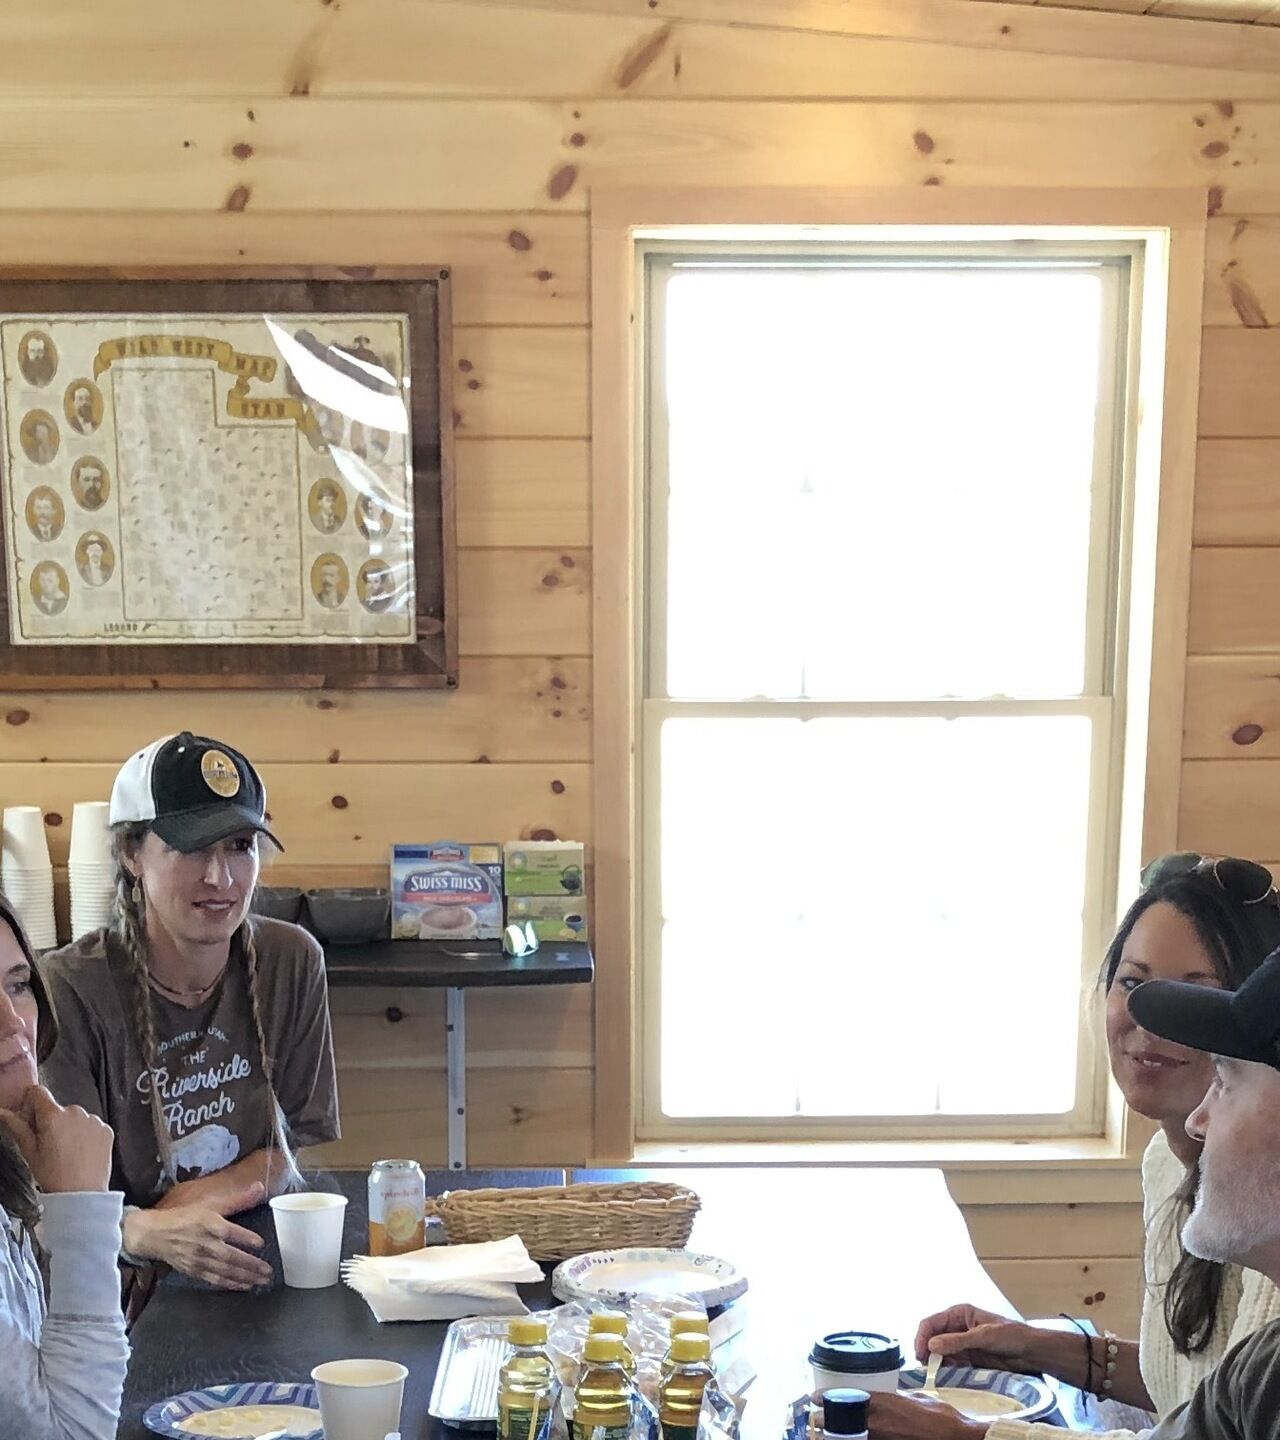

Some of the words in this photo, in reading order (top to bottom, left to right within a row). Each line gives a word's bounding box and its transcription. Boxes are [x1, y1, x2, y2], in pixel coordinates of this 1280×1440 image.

[116, 340, 159, 355] WILD
[172, 340, 215, 355] WEST
[235, 355, 272, 374] MAP
[241, 402, 285, 418] UTAH
[489, 866, 501, 874] 10
[136, 1054, 252, 1098] Riverside
[141, 1091, 235, 1135] Ranch
